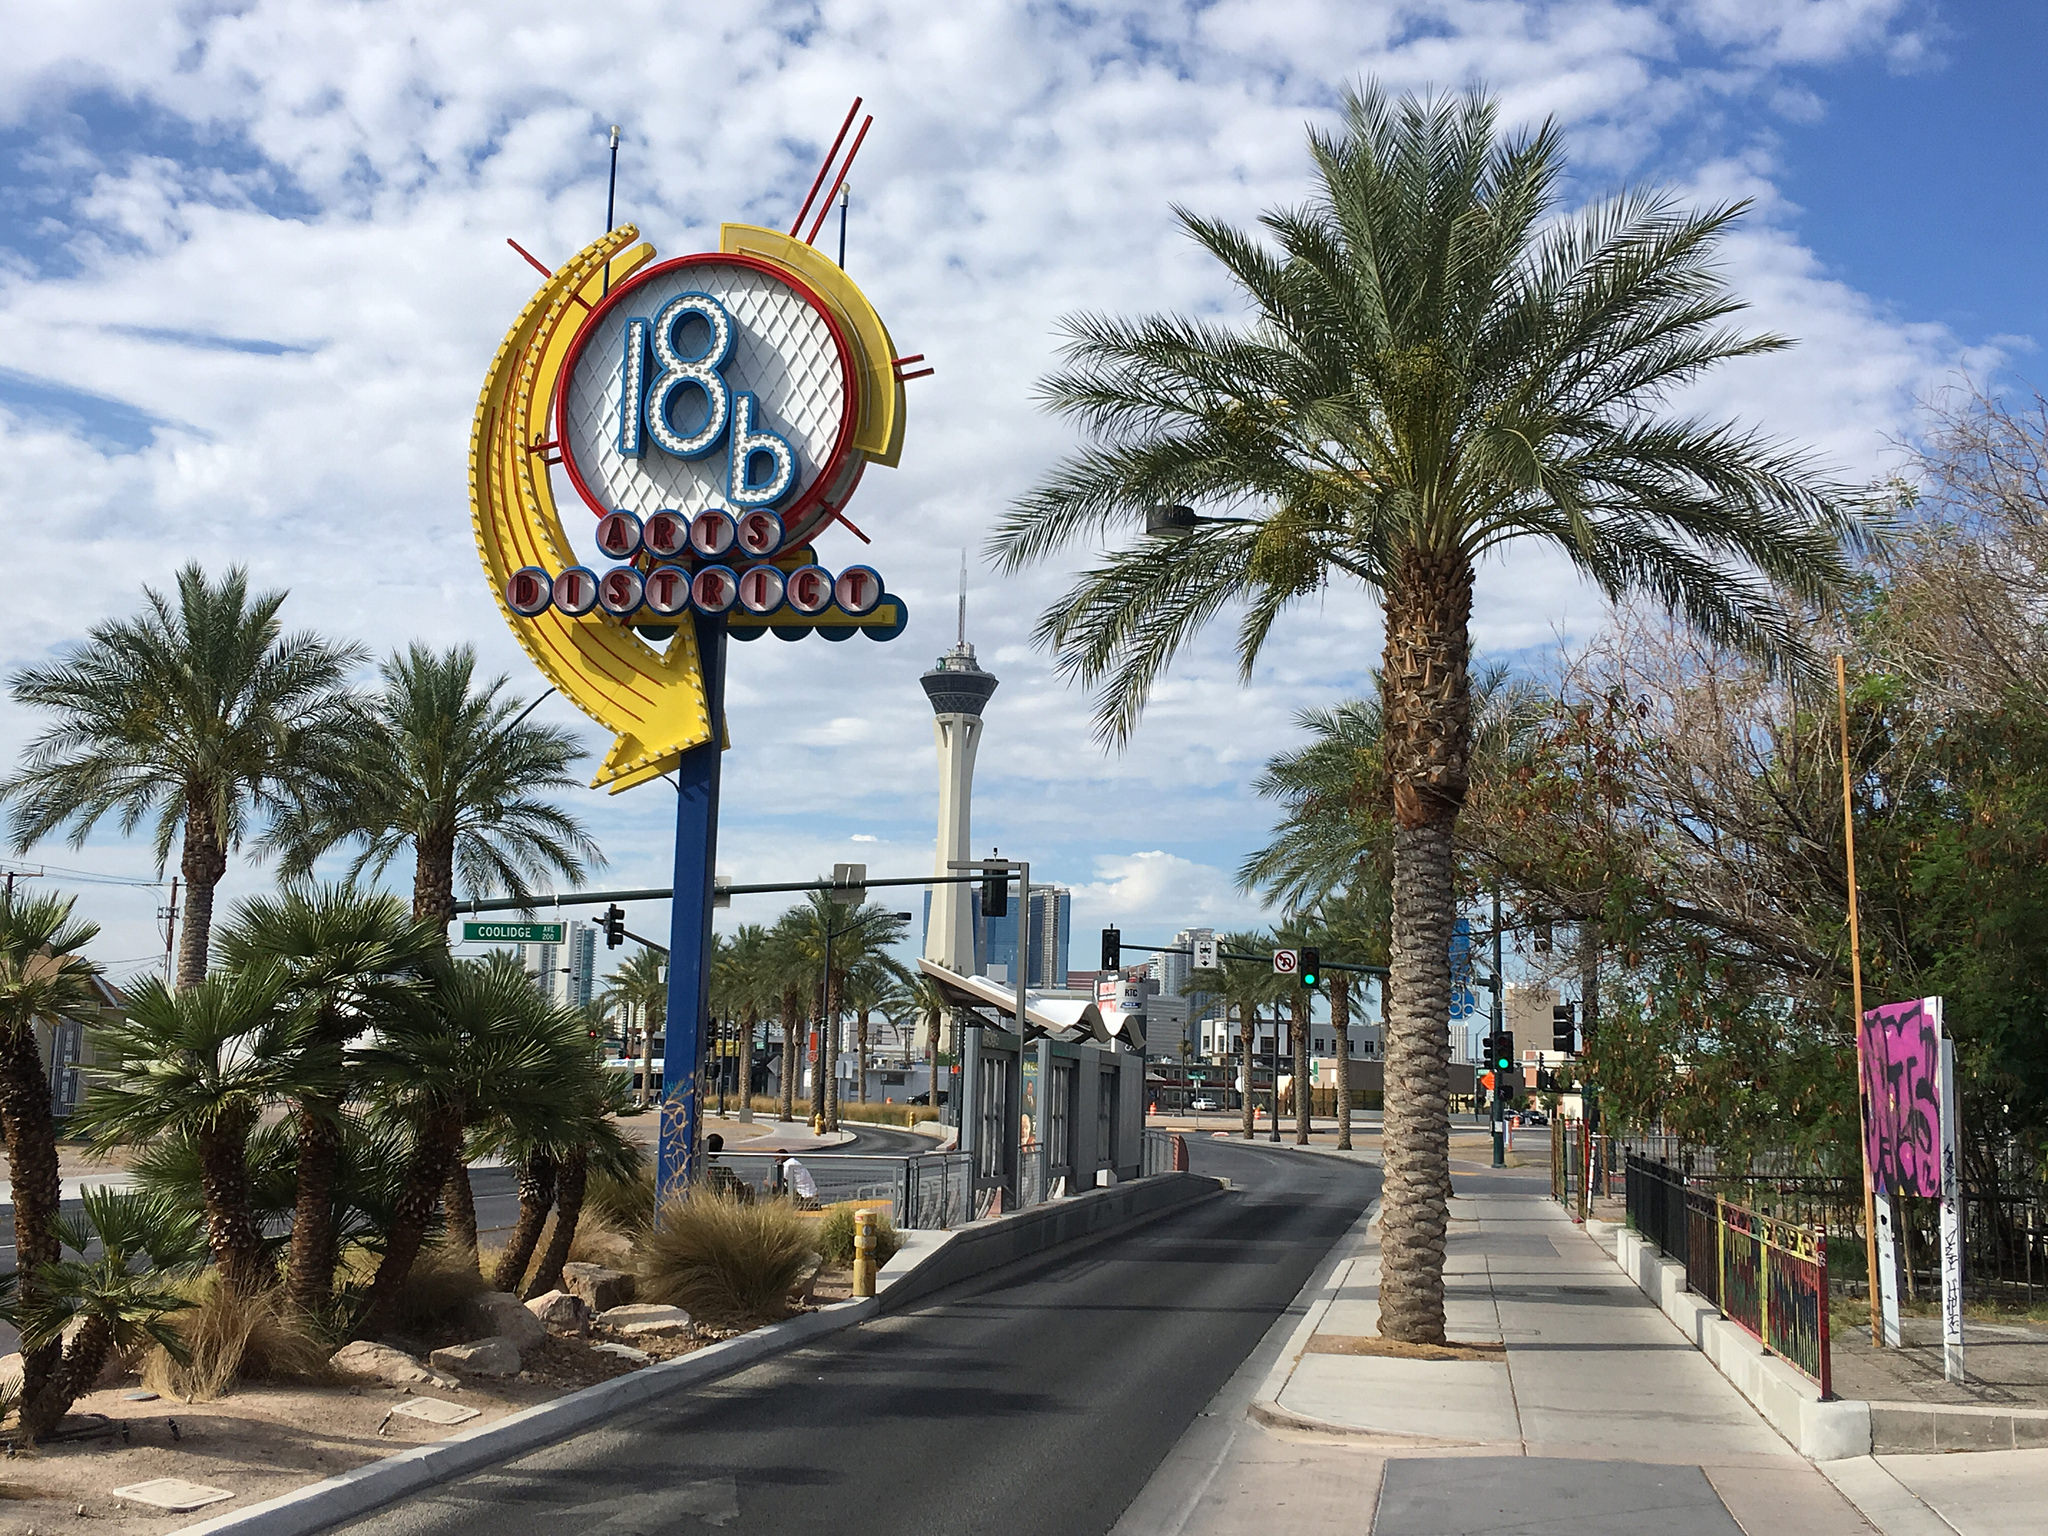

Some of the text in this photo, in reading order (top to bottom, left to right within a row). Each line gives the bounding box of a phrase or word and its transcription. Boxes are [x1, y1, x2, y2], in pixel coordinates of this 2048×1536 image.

[618, 291, 801, 507] 18b
[604, 514, 770, 550] ARTS
[514, 568, 870, 607] DISTRICT
[478, 925, 555, 938] COOLIDGE AVE
[542, 933, 555, 941] 200
[1124, 988, 1138, 997] RTC
